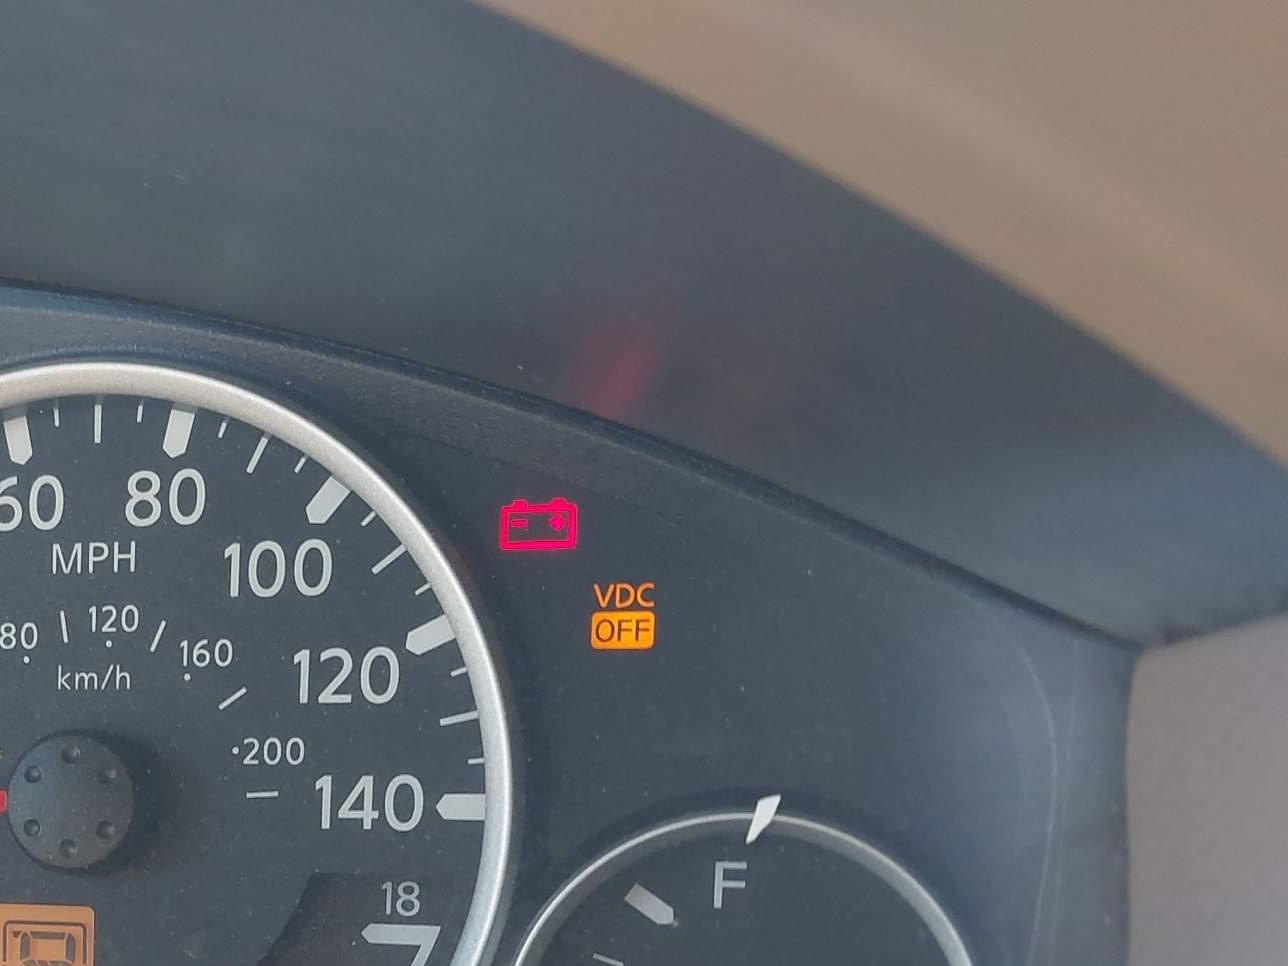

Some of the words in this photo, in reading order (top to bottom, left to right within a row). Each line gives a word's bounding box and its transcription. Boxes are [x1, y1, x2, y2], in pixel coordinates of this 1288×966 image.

[125, 468, 206, 527] 80
[52, 540, 136, 575] MPH
[224, 538, 333, 598] 100
[593, 582, 655, 608] VDC
[88, 604, 139, 633] 120
[595, 619, 650, 643] OFF
[0, 622, 38, 650] 80
[180, 638, 233, 668] 160
[57, 663, 132, 692] km/h
[293, 647, 400, 704] 120
[242, 737, 305, 766] 200
[315, 774, 424, 832] 140
[382, 881, 420, 917] 18
[713, 861, 748, 909] F
